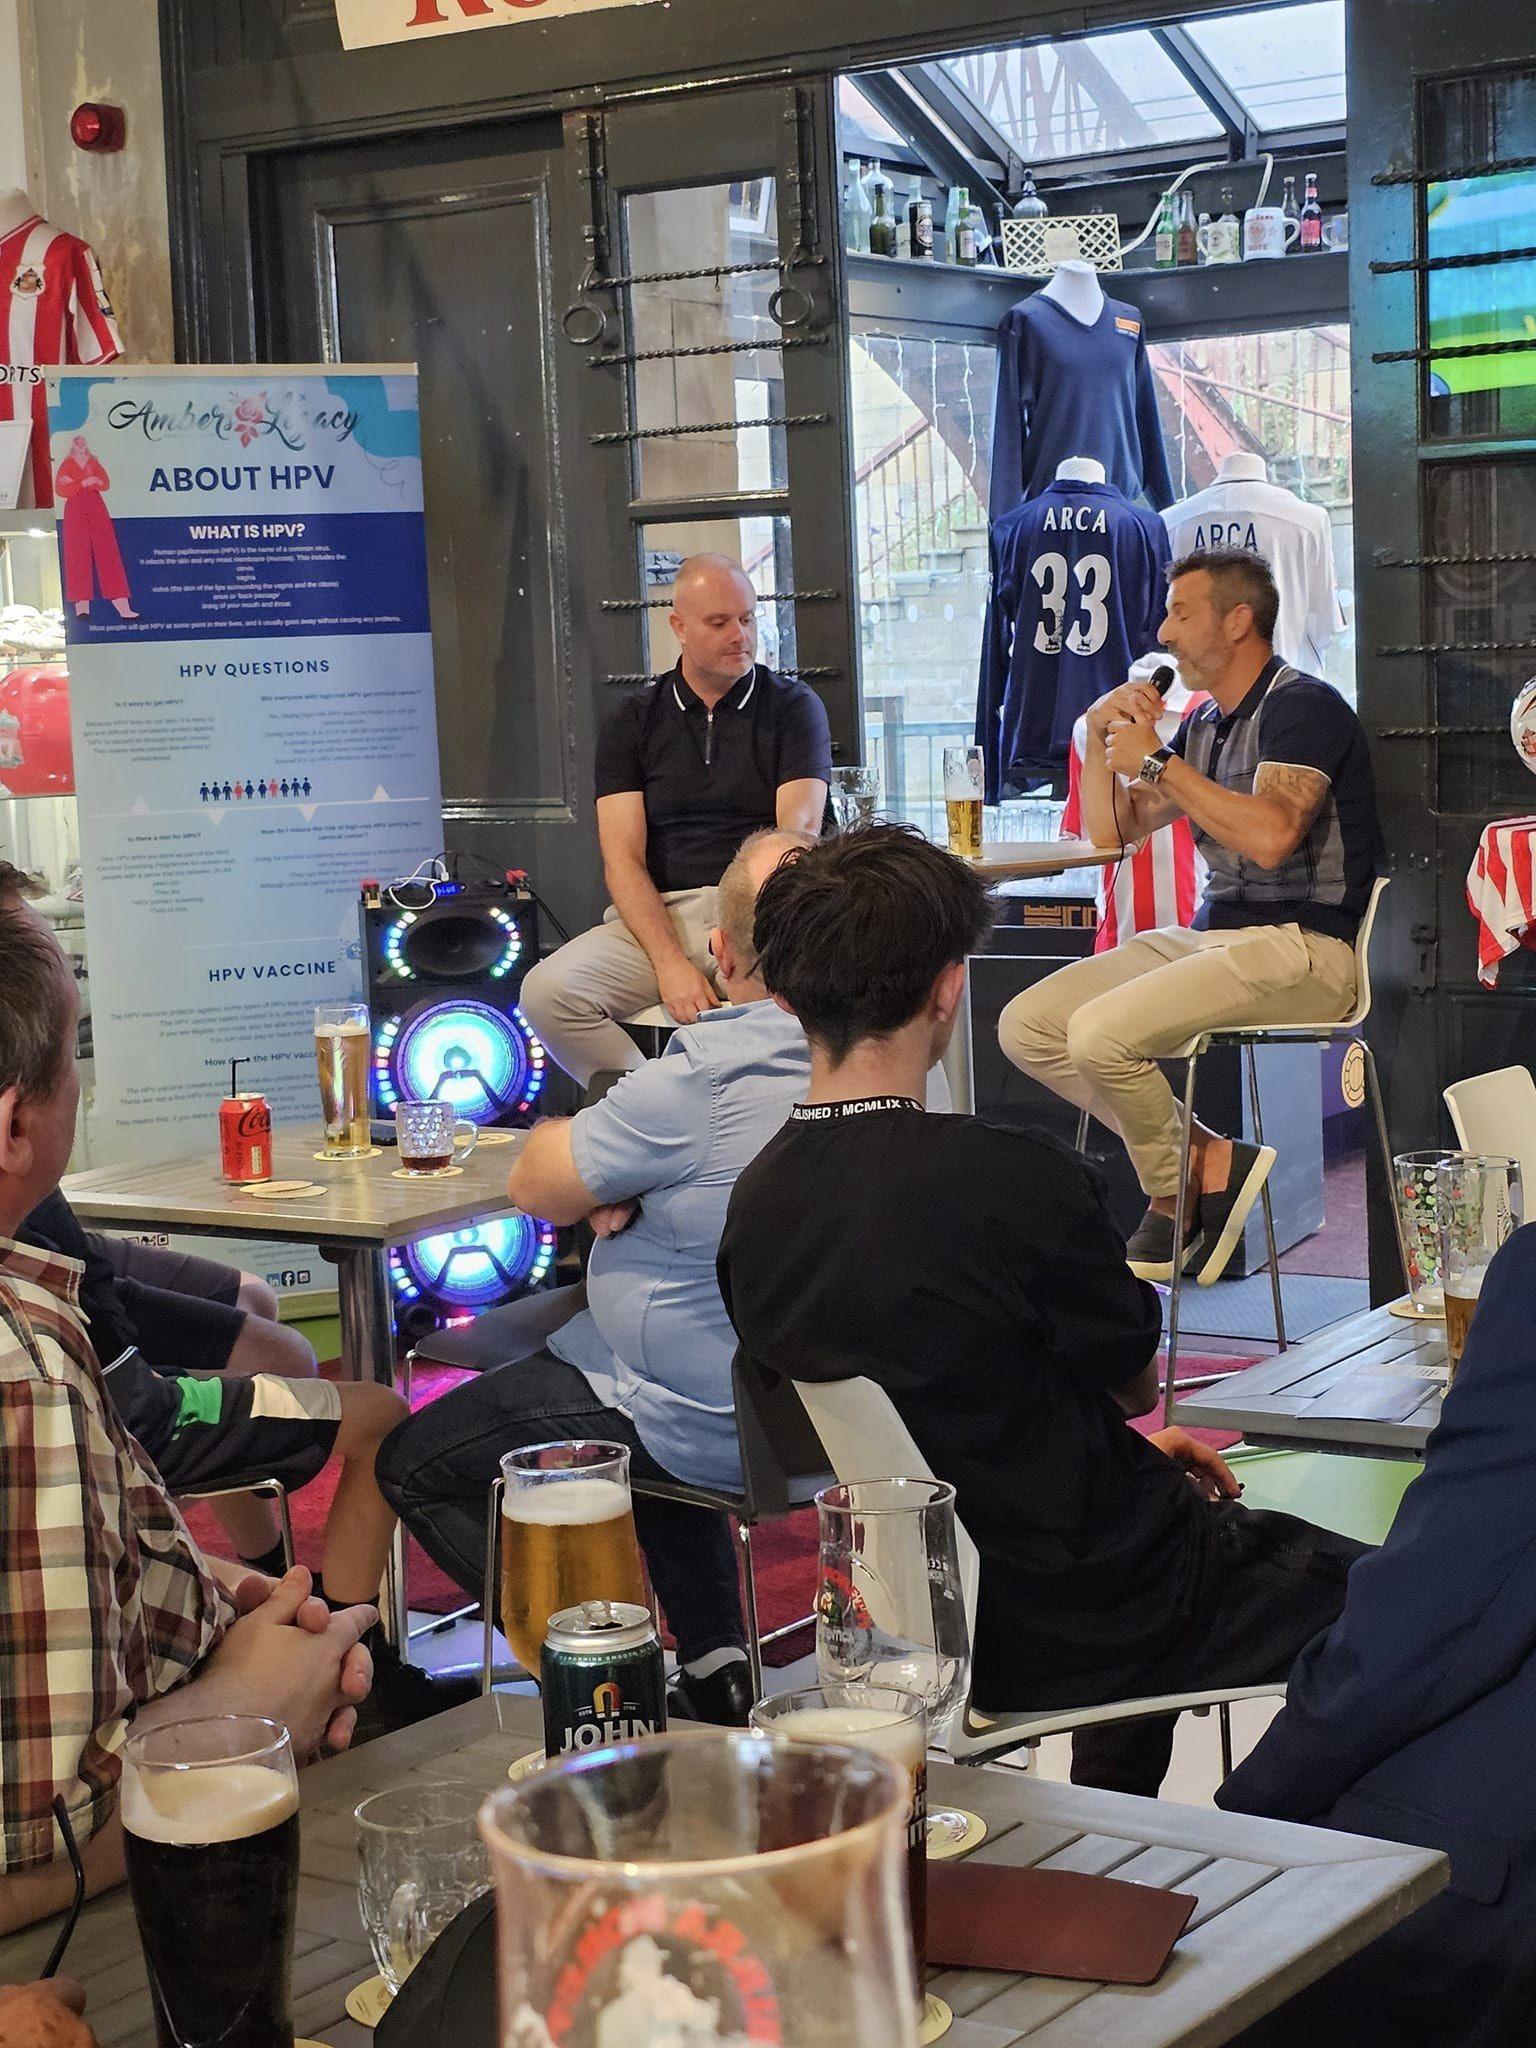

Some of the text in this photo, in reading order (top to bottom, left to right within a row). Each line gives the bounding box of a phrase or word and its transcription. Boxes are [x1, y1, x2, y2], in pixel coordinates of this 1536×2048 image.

[149, 465, 335, 492] ABOUT HPV
[189, 523, 306, 539] WHAT IS HPV?
[1043, 507, 1106, 533] ARCA
[1195, 522, 1258, 551] ARCA
[1031, 552, 1111, 657] 33
[180, 659, 330, 678] HPV QUESTIONS
[209, 960, 337, 982] HPV VACCINE
[204, 1058, 225, 1067] How
[253, 1054, 269, 1063] the
[271, 1052, 292, 1061] HPV
[294, 1051, 317, 1059] vacci
[842, 1099, 901, 1116] MCMLIX
[560, 1720, 656, 1753] JOHN
